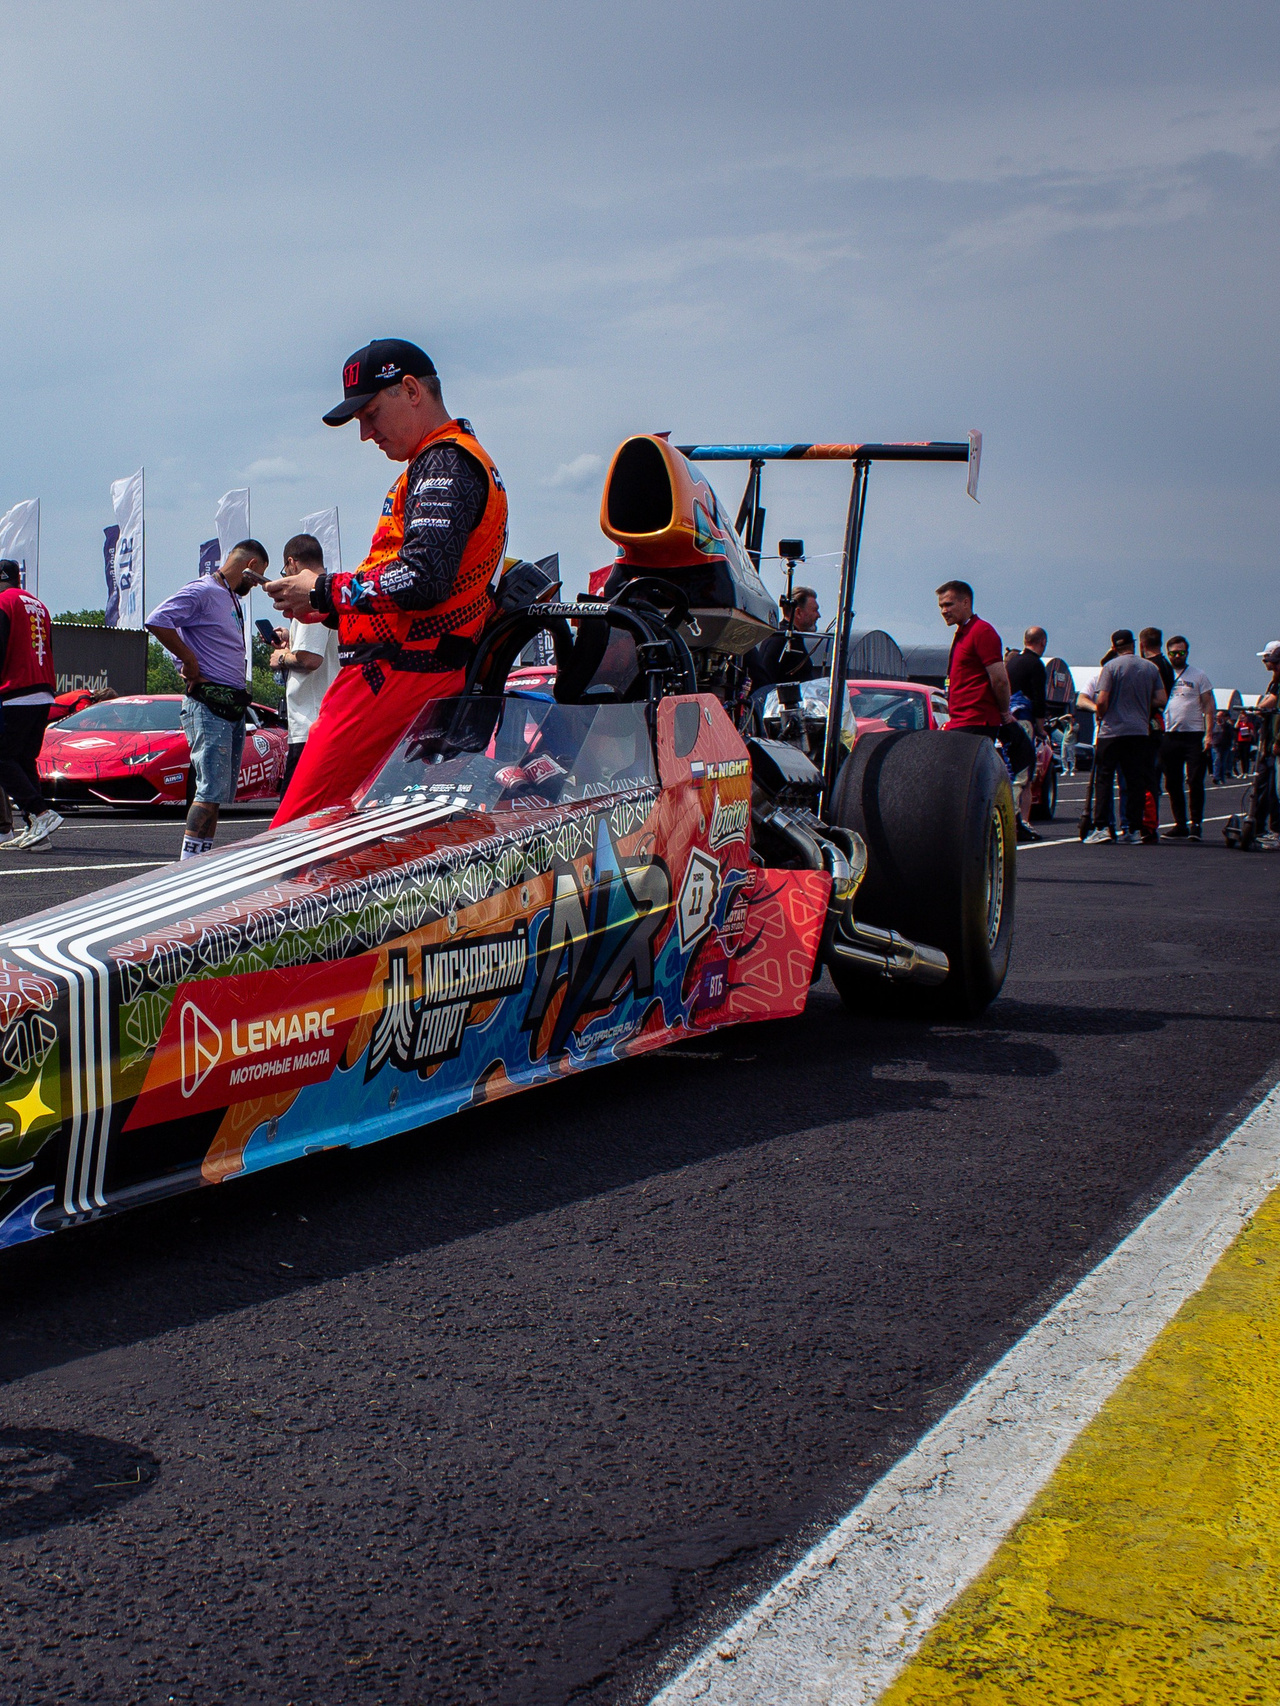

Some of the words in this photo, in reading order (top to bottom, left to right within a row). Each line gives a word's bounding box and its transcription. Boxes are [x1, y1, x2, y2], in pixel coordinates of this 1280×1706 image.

[380, 565, 409, 581] NIGHT
[381, 571, 416, 588] RACER
[382, 579, 414, 595] TEAM
[707, 759, 750, 780] K.NIGHT
[688, 886, 704, 917] 11
[424, 928, 526, 1006] МОСКОВСКИЙ
[709, 973, 723, 998] ВТБ
[231, 1007, 336, 1056] LEMARC
[414, 1001, 470, 1060] СПОРТ
[229, 1056, 293, 1087] МОТОРНЫЕ
[292, 1048, 330, 1072] МАСЛА
